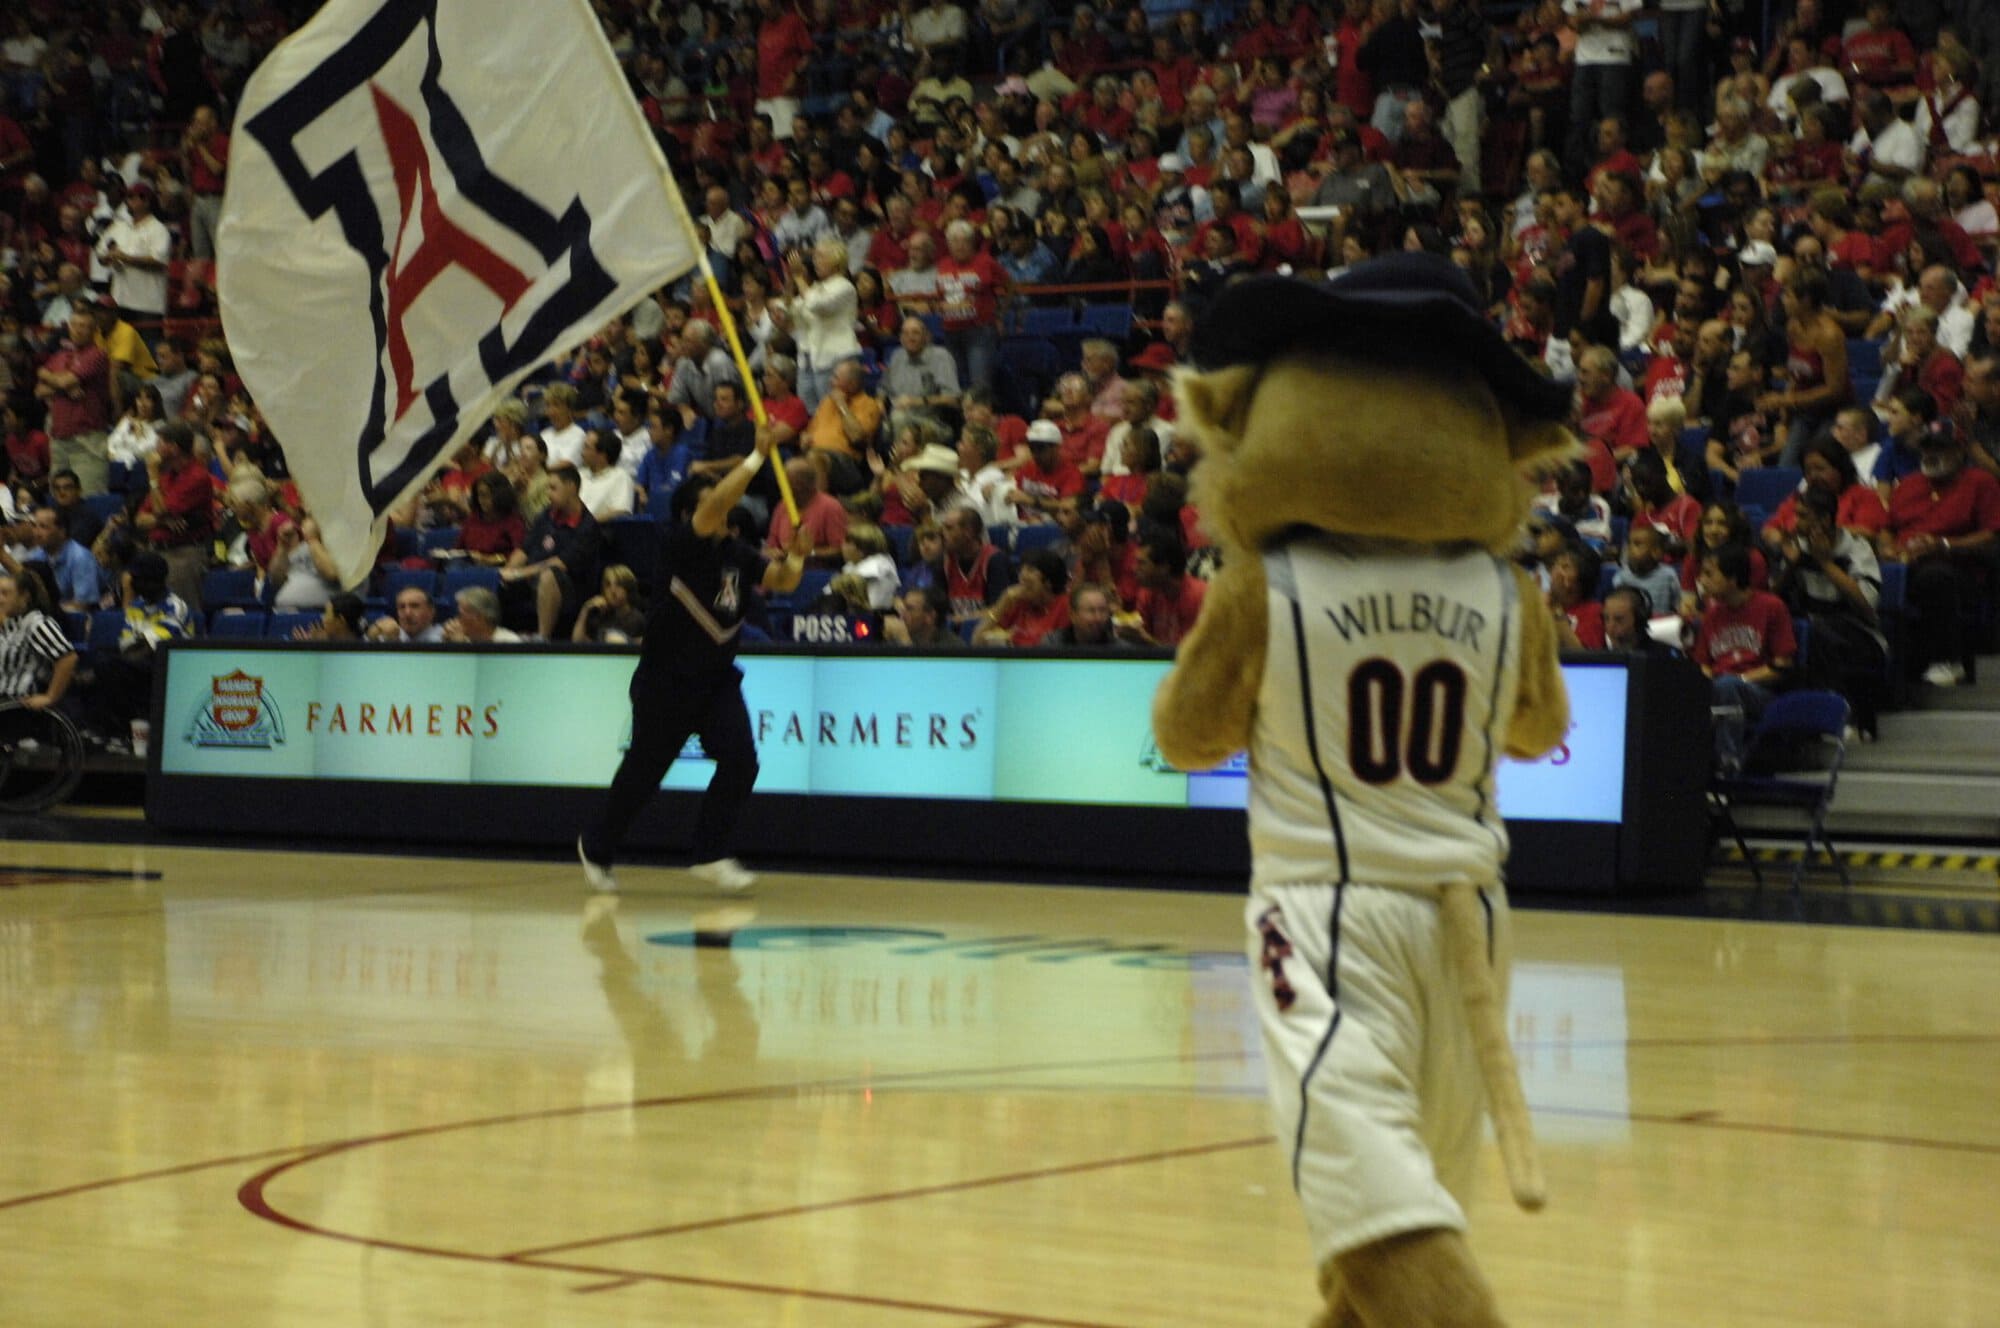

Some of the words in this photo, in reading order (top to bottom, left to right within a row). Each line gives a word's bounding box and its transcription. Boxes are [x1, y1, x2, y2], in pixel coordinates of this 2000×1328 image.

[1325, 592, 1487, 652] WILBUR
[306, 702, 499, 738] FARMERS
[758, 710, 978, 749] FARMERS
[1347, 656, 1467, 786] 00
